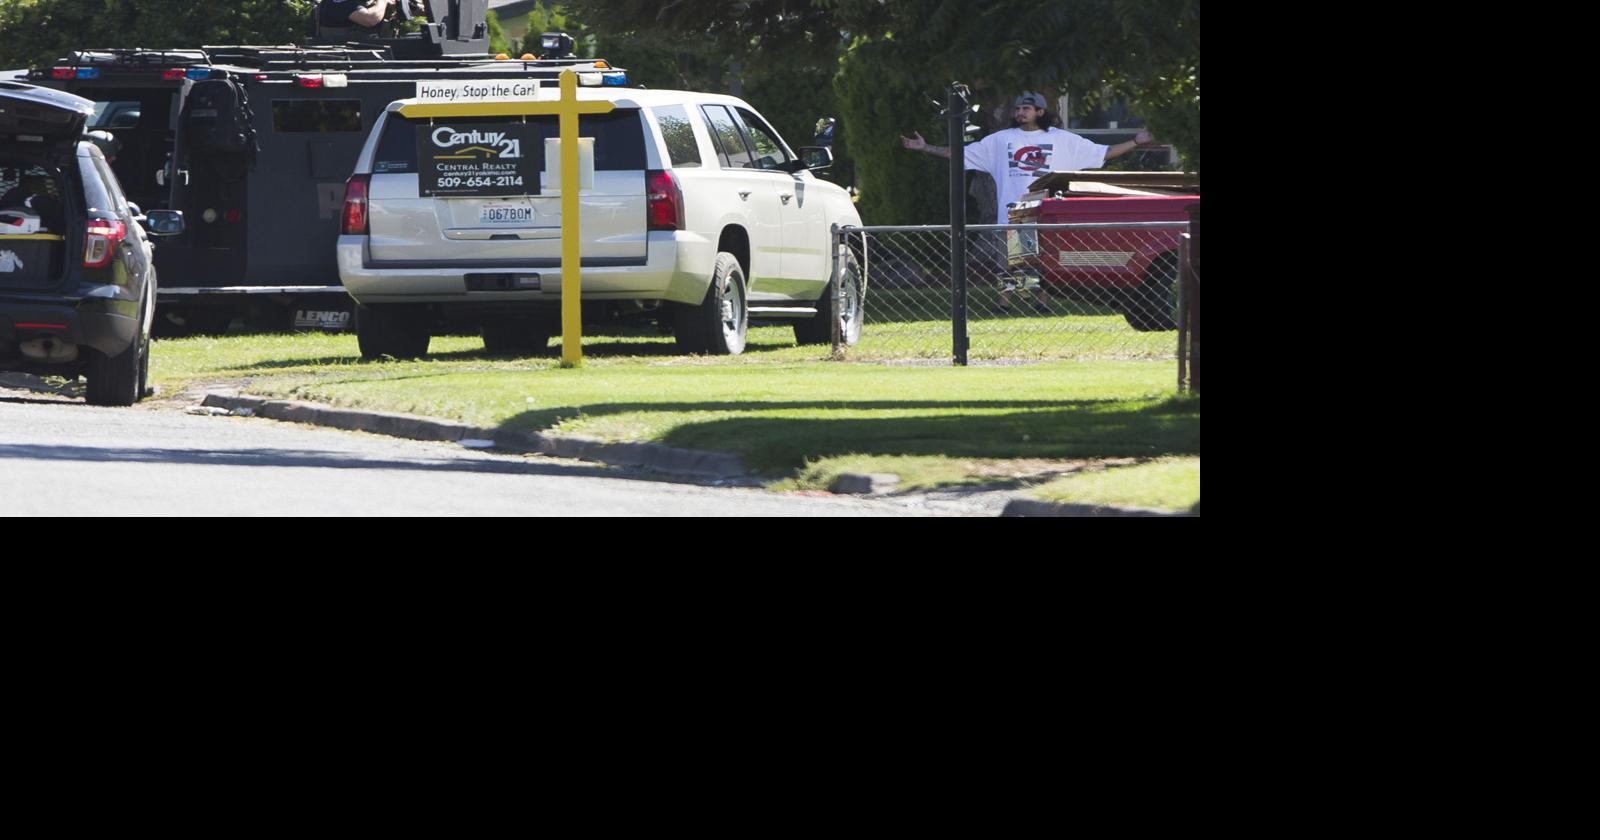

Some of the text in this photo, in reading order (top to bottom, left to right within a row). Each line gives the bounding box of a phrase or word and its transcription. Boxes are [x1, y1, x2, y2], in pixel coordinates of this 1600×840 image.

[421, 84, 535, 101] Honey, Stop the Car!
[431, 126, 506, 148] Century
[499, 139, 520, 158] 21
[436, 162, 517, 171] CENTRAL REALTY
[437, 176, 523, 187] 509-654-2114
[295, 310, 350, 322] LENCO
